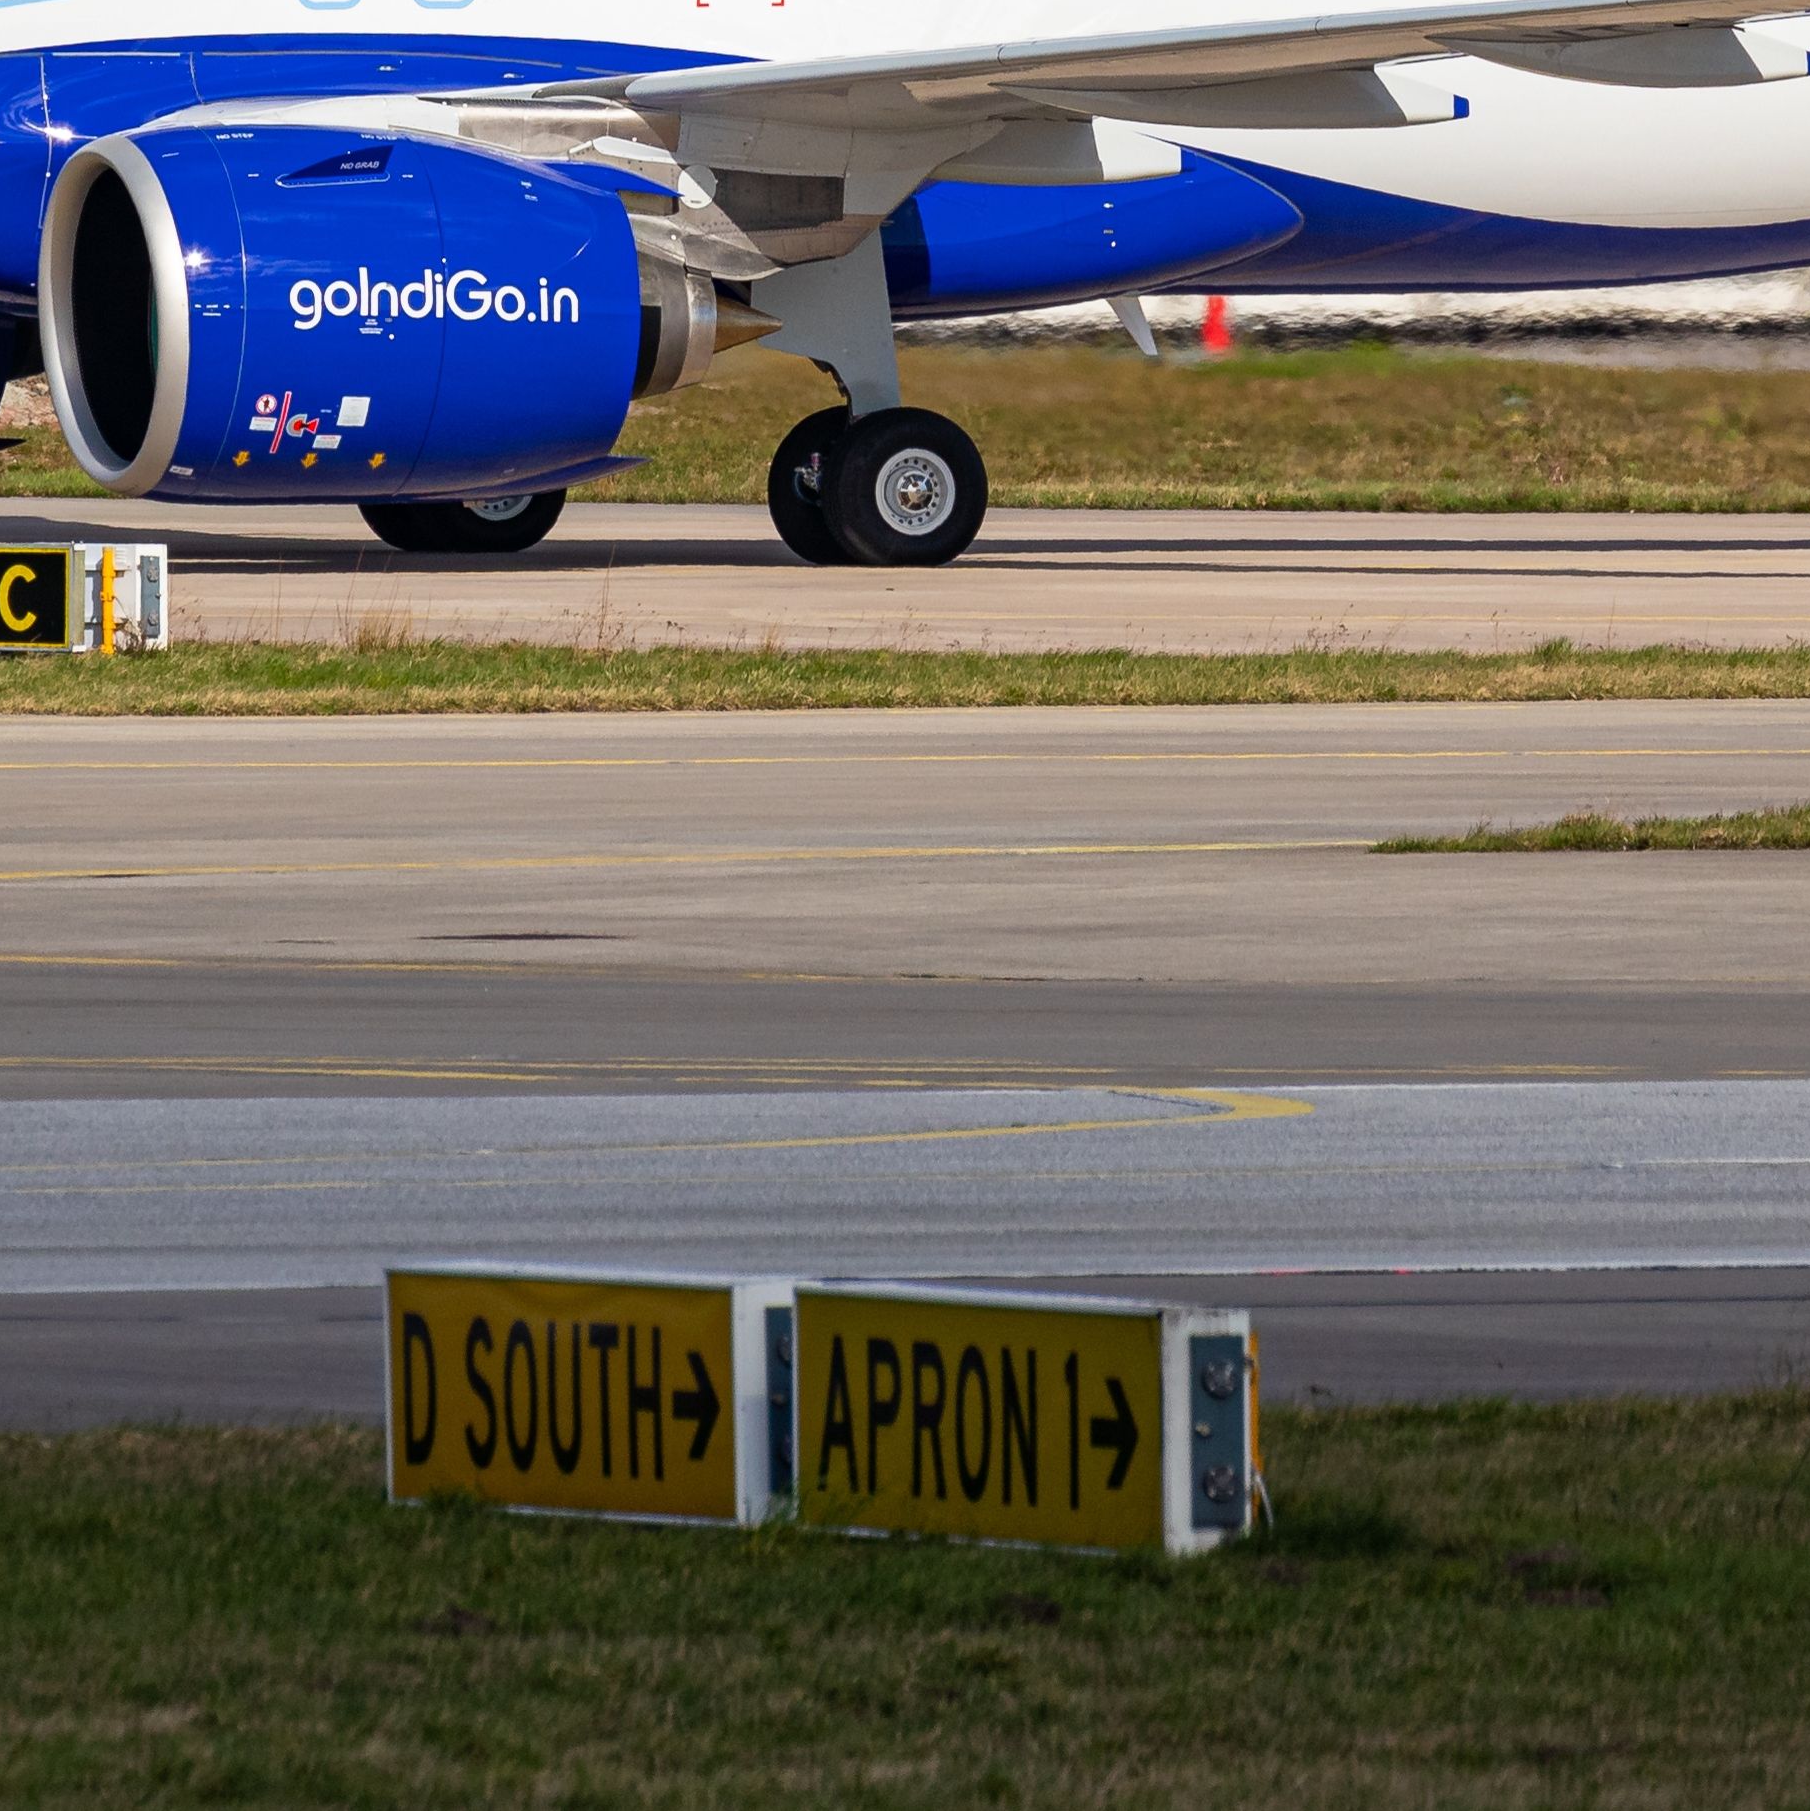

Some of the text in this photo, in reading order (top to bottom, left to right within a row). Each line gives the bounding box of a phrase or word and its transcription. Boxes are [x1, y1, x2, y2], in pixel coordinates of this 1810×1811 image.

[355, 161, 380, 170] GRAB
[289, 267, 579, 330] goIndiGo.in
[402, 1310, 664, 1481] D SOUTH
[817, 1333, 1080, 1510] APRON 1
